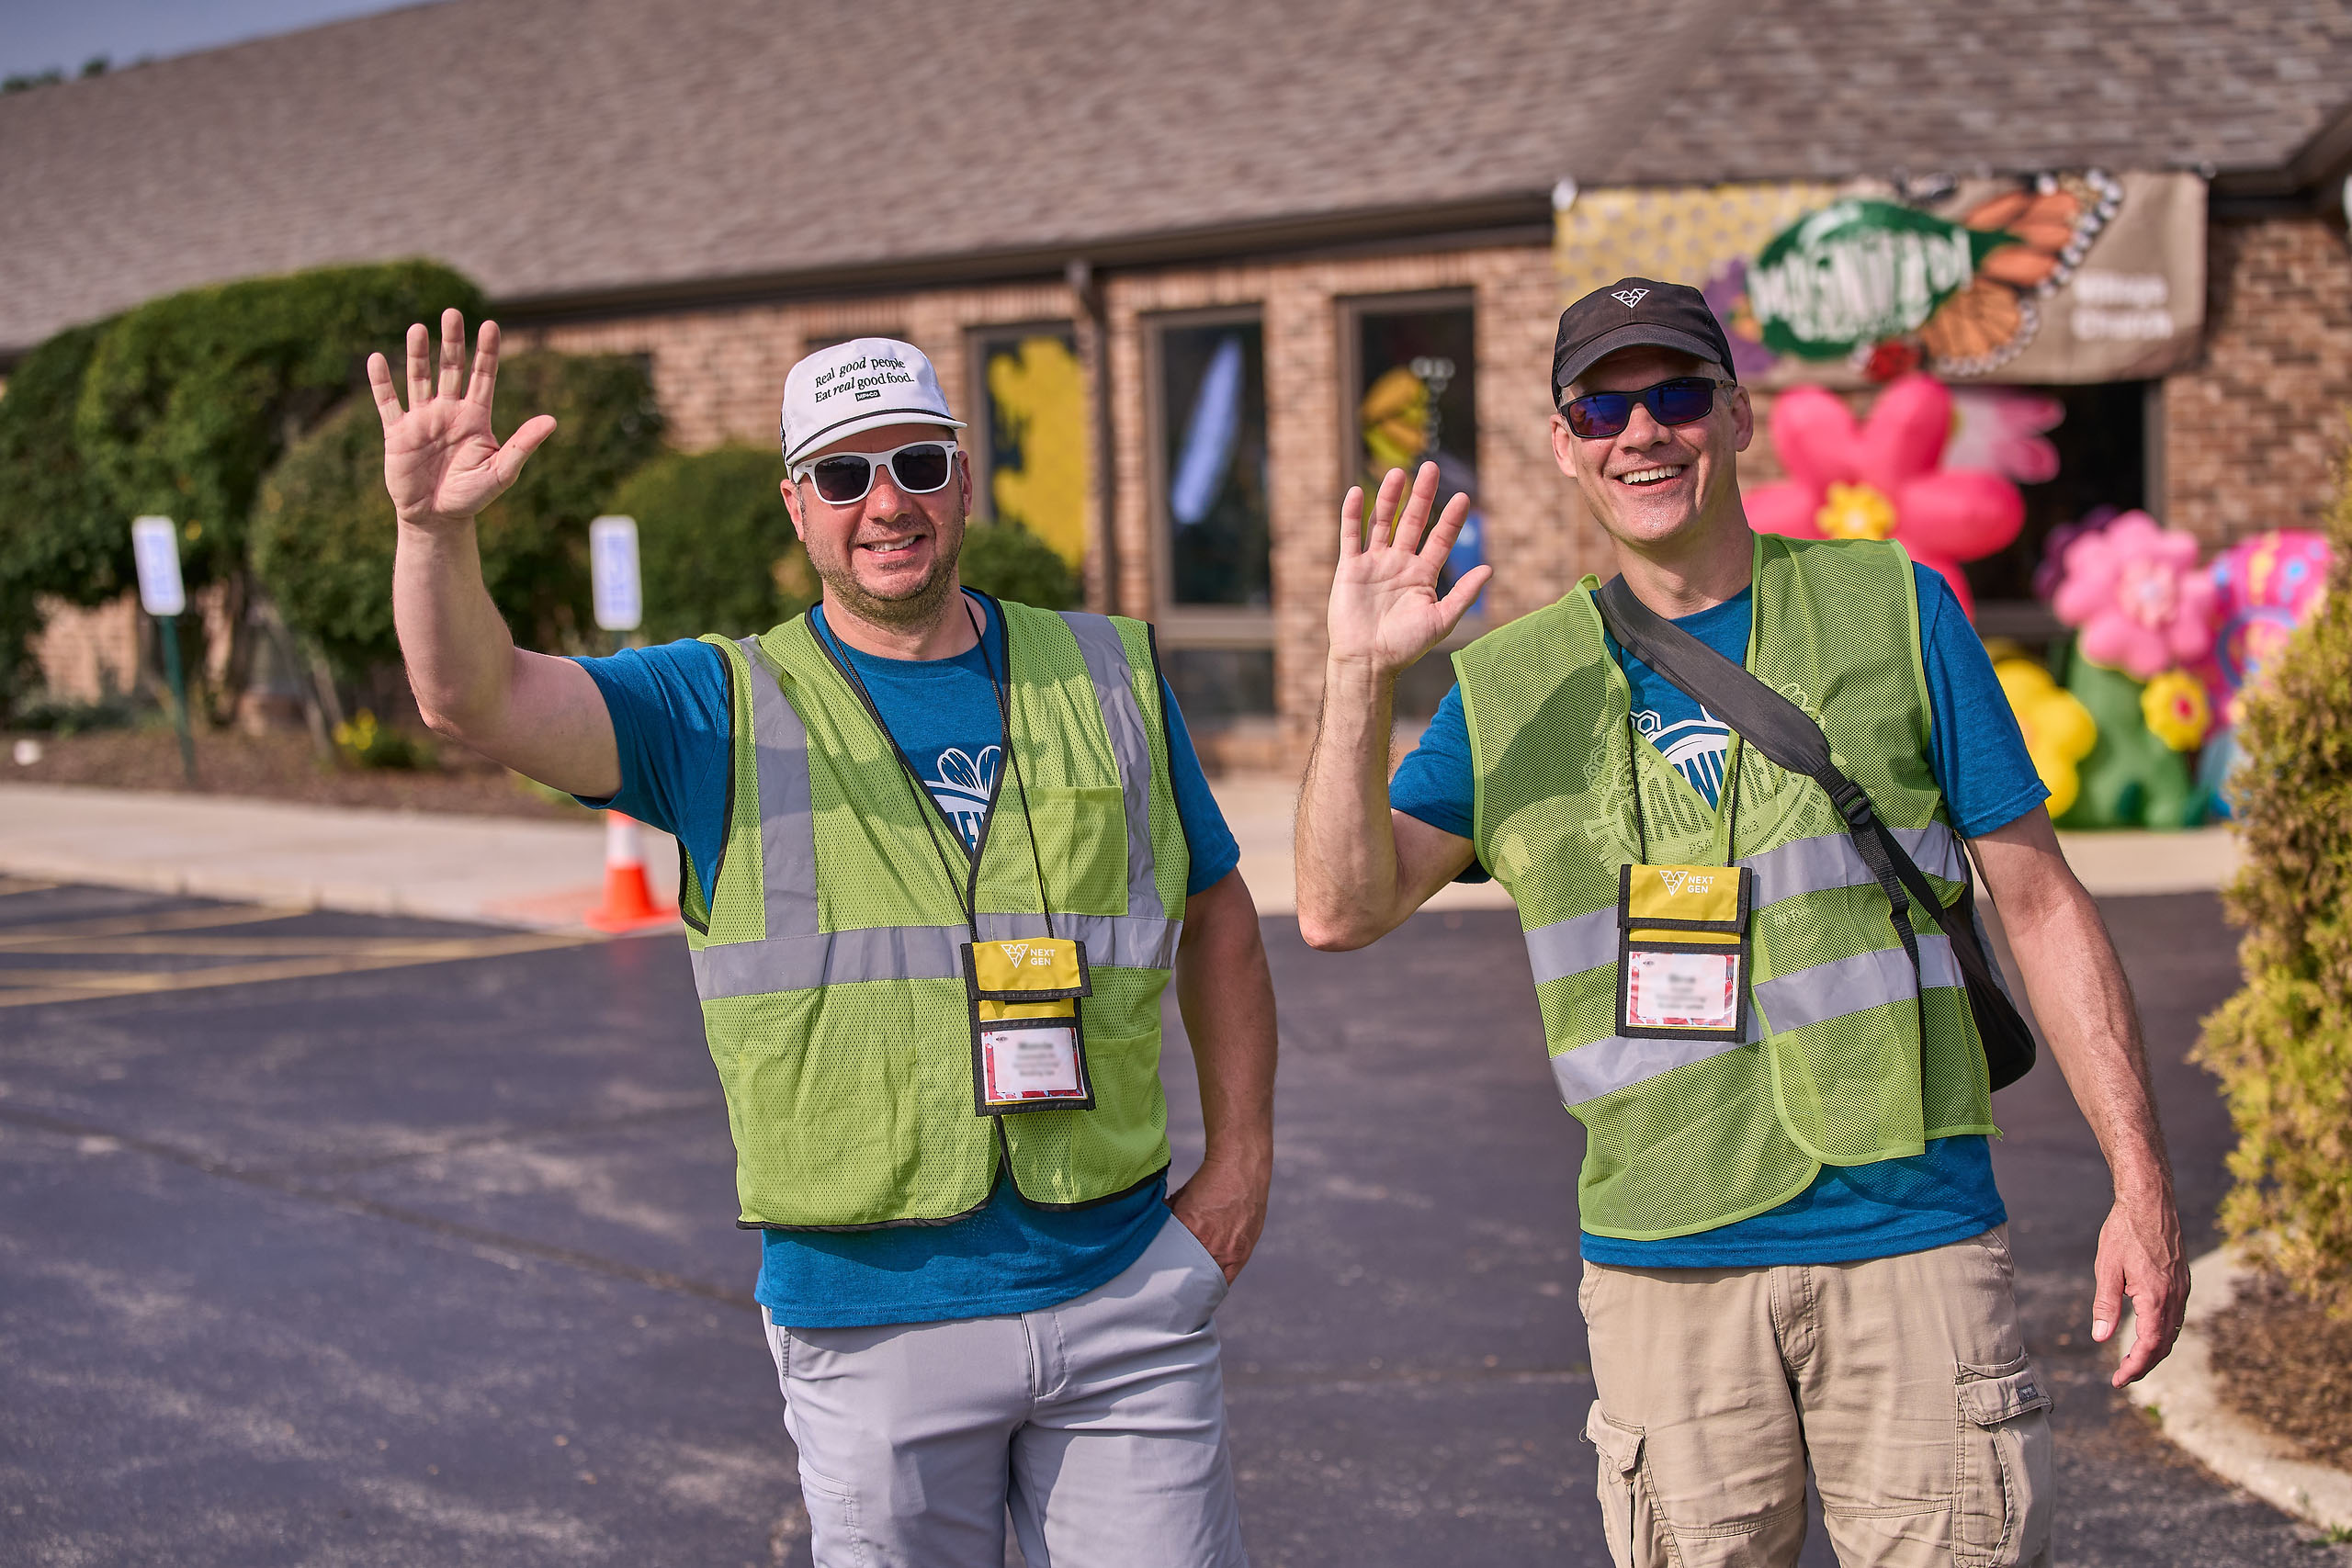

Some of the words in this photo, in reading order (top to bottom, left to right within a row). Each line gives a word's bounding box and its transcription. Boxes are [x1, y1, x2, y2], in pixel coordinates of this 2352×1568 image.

[815, 367, 835, 388] Real
[839, 356, 866, 378] good
[870, 357, 906, 370] people
[815, 389, 832, 403] Eat
[832, 377, 855, 396] real
[857, 374, 887, 390] good
[887, 372, 915, 385] food.
[1688, 875, 1715, 885] NEXT
[1687, 885, 1709, 894] GEN
[1030, 948, 1056, 957] NEXT
[1030, 957, 1051, 966] GEN
